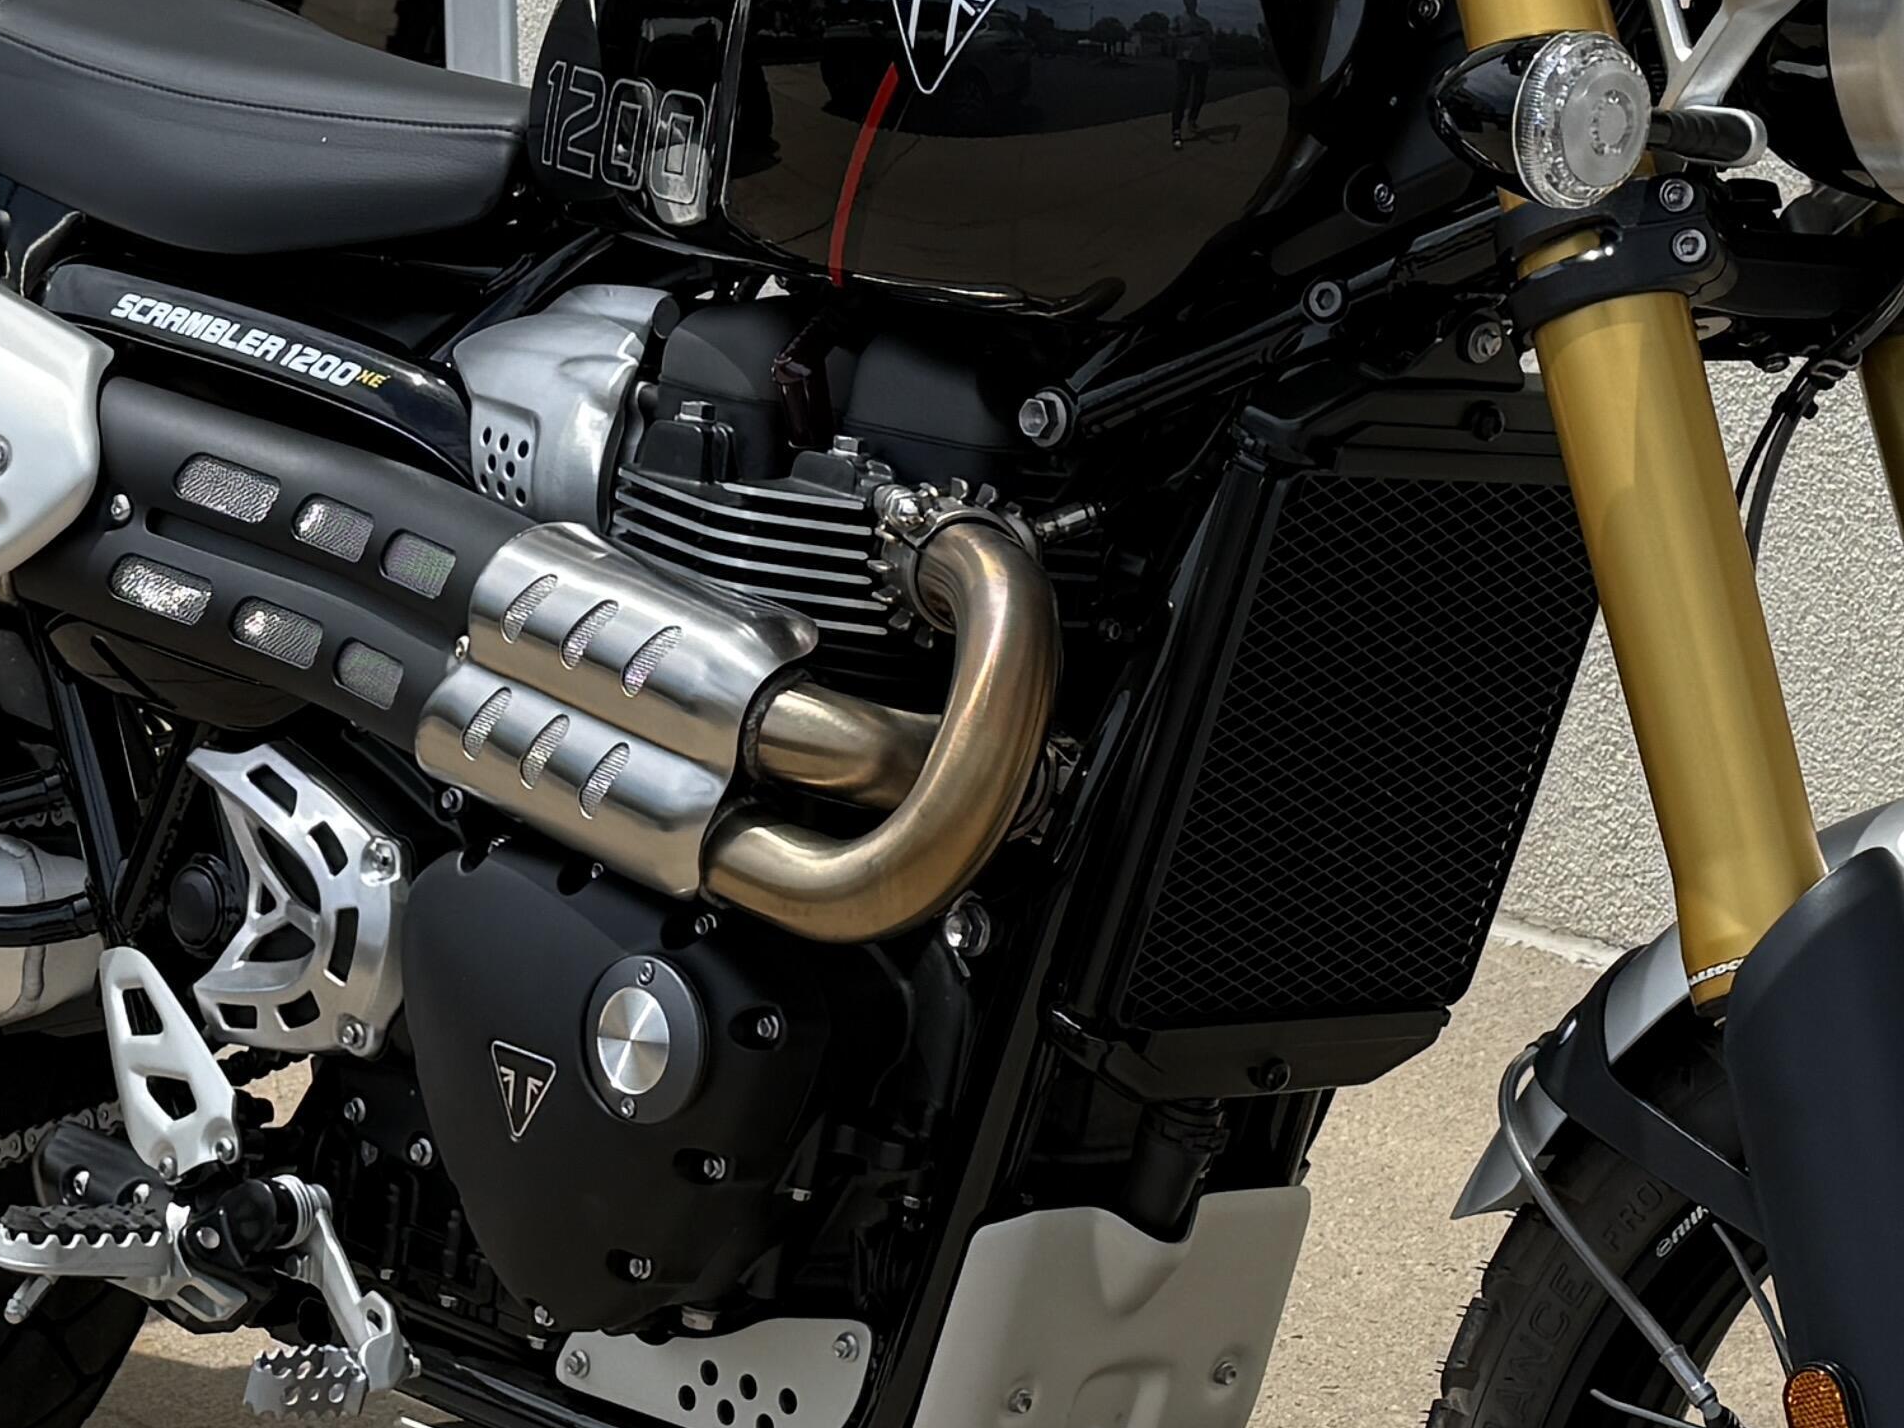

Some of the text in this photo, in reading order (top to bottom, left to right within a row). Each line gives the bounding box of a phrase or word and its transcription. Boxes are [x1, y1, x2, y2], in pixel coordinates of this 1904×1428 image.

[542, 60, 706, 205] 1200
[110, 292, 286, 362] SCRAMBLER
[279, 343, 361, 387] 1200
[1601, 1179, 1664, 1254] FRO
